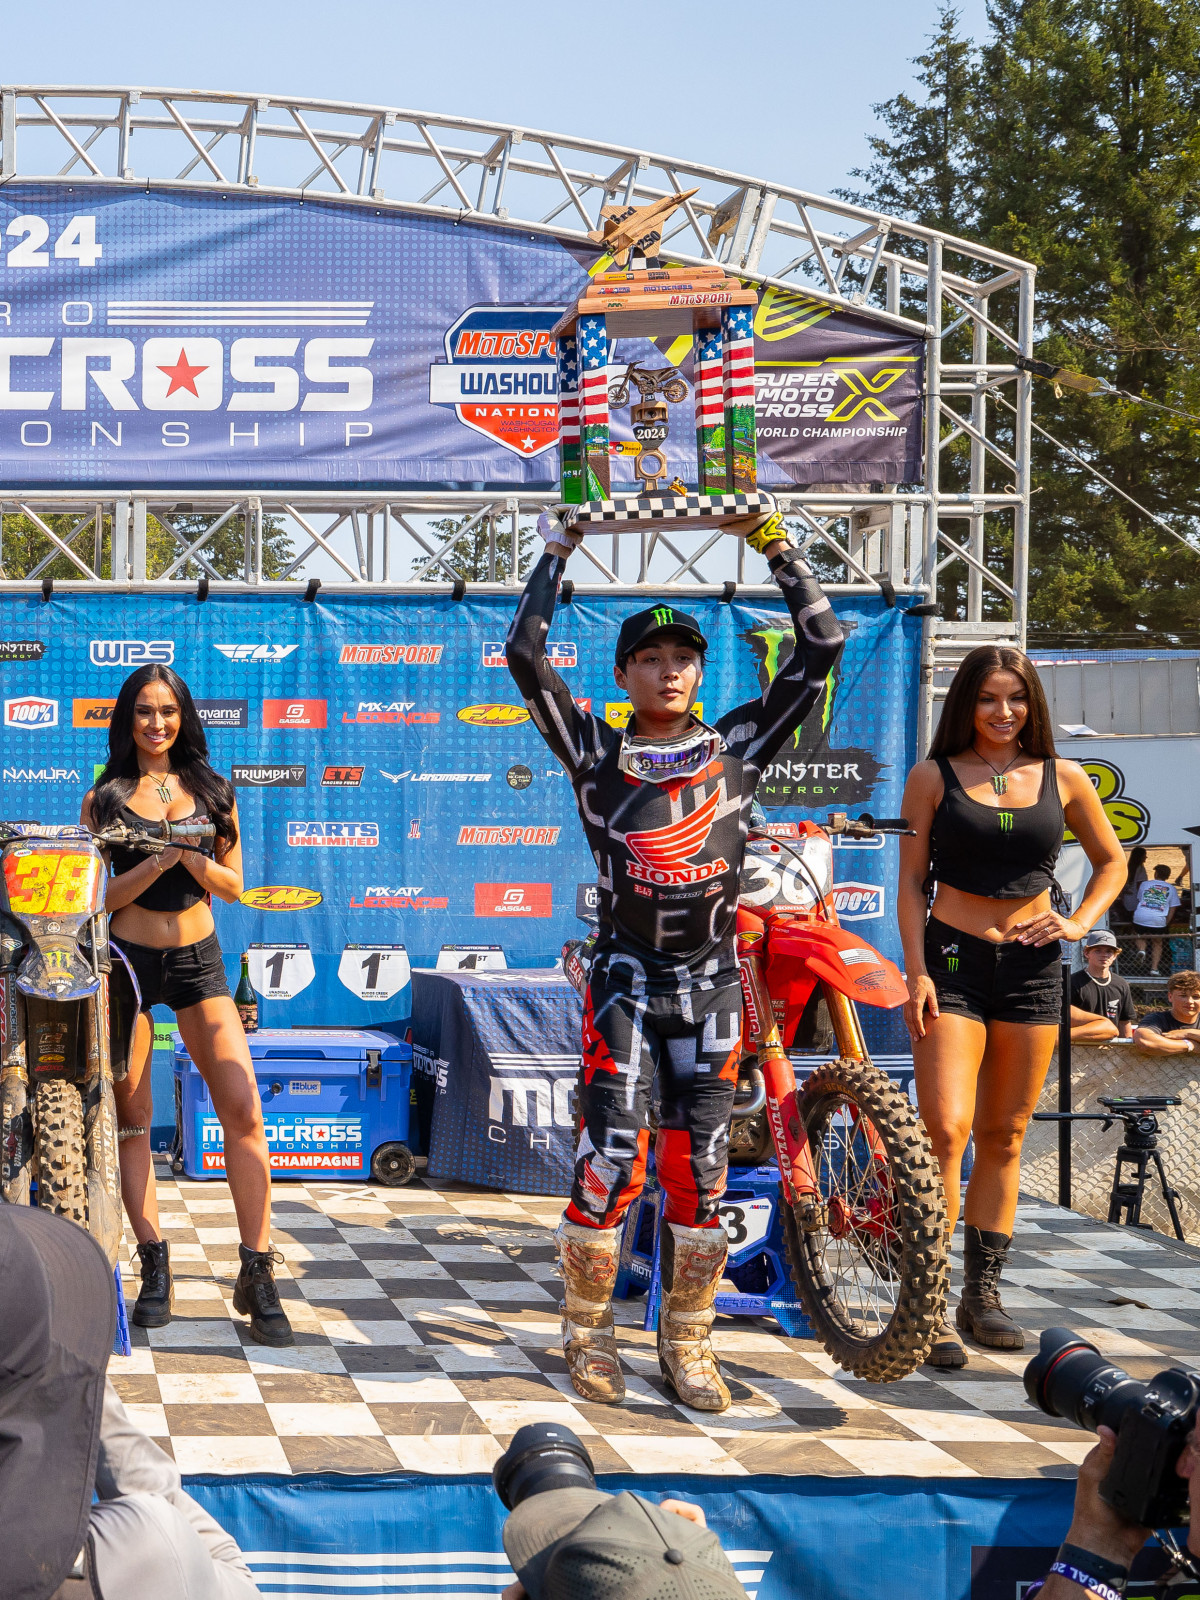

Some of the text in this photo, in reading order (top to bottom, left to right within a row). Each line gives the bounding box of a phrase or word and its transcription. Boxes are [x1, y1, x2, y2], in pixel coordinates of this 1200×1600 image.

[610, 206, 637, 224] 3rd
[461, 373, 557, 395] WASHOU
[754, 373, 839, 387] SUPER
[757, 388, 835, 402] MOTO
[476, 408, 555, 417] NATION
[754, 404, 835, 418] CROSS
[637, 427, 666, 439] 2024
[755, 427, 907, 438] WORLD CHAMPIONSHIP
[91, 641, 174, 666] WPS
[214, 644, 299, 659] FLY
[12, 704, 50, 721] 100%
[197, 708, 240, 723] qvarna
[342, 712, 440, 726] LEGENDS
[458, 706, 531, 720] FMF
[3, 766, 80, 780] NAMURA
[233, 769, 289, 779] TRIUMPH
[324, 767, 363, 779] ETS
[411, 773, 492, 782] LANDMASTER
[288, 822, 379, 836] PARTS
[288, 836, 379, 846] UNLIMITED
[627, 858, 729, 886] HONDA
[10, 854, 100, 914] 38
[241, 891, 321, 905] FMF
[350, 897, 448, 911] LEGENDS
[299, 1082, 318, 1091] blue
[203, 1126, 362, 1142] MOCROSS
[769, 1096, 792, 1182] DUNLOP
[270, 1156, 360, 1167] CHAMPAGNE
[718, 1206, 748, 1244] 3
